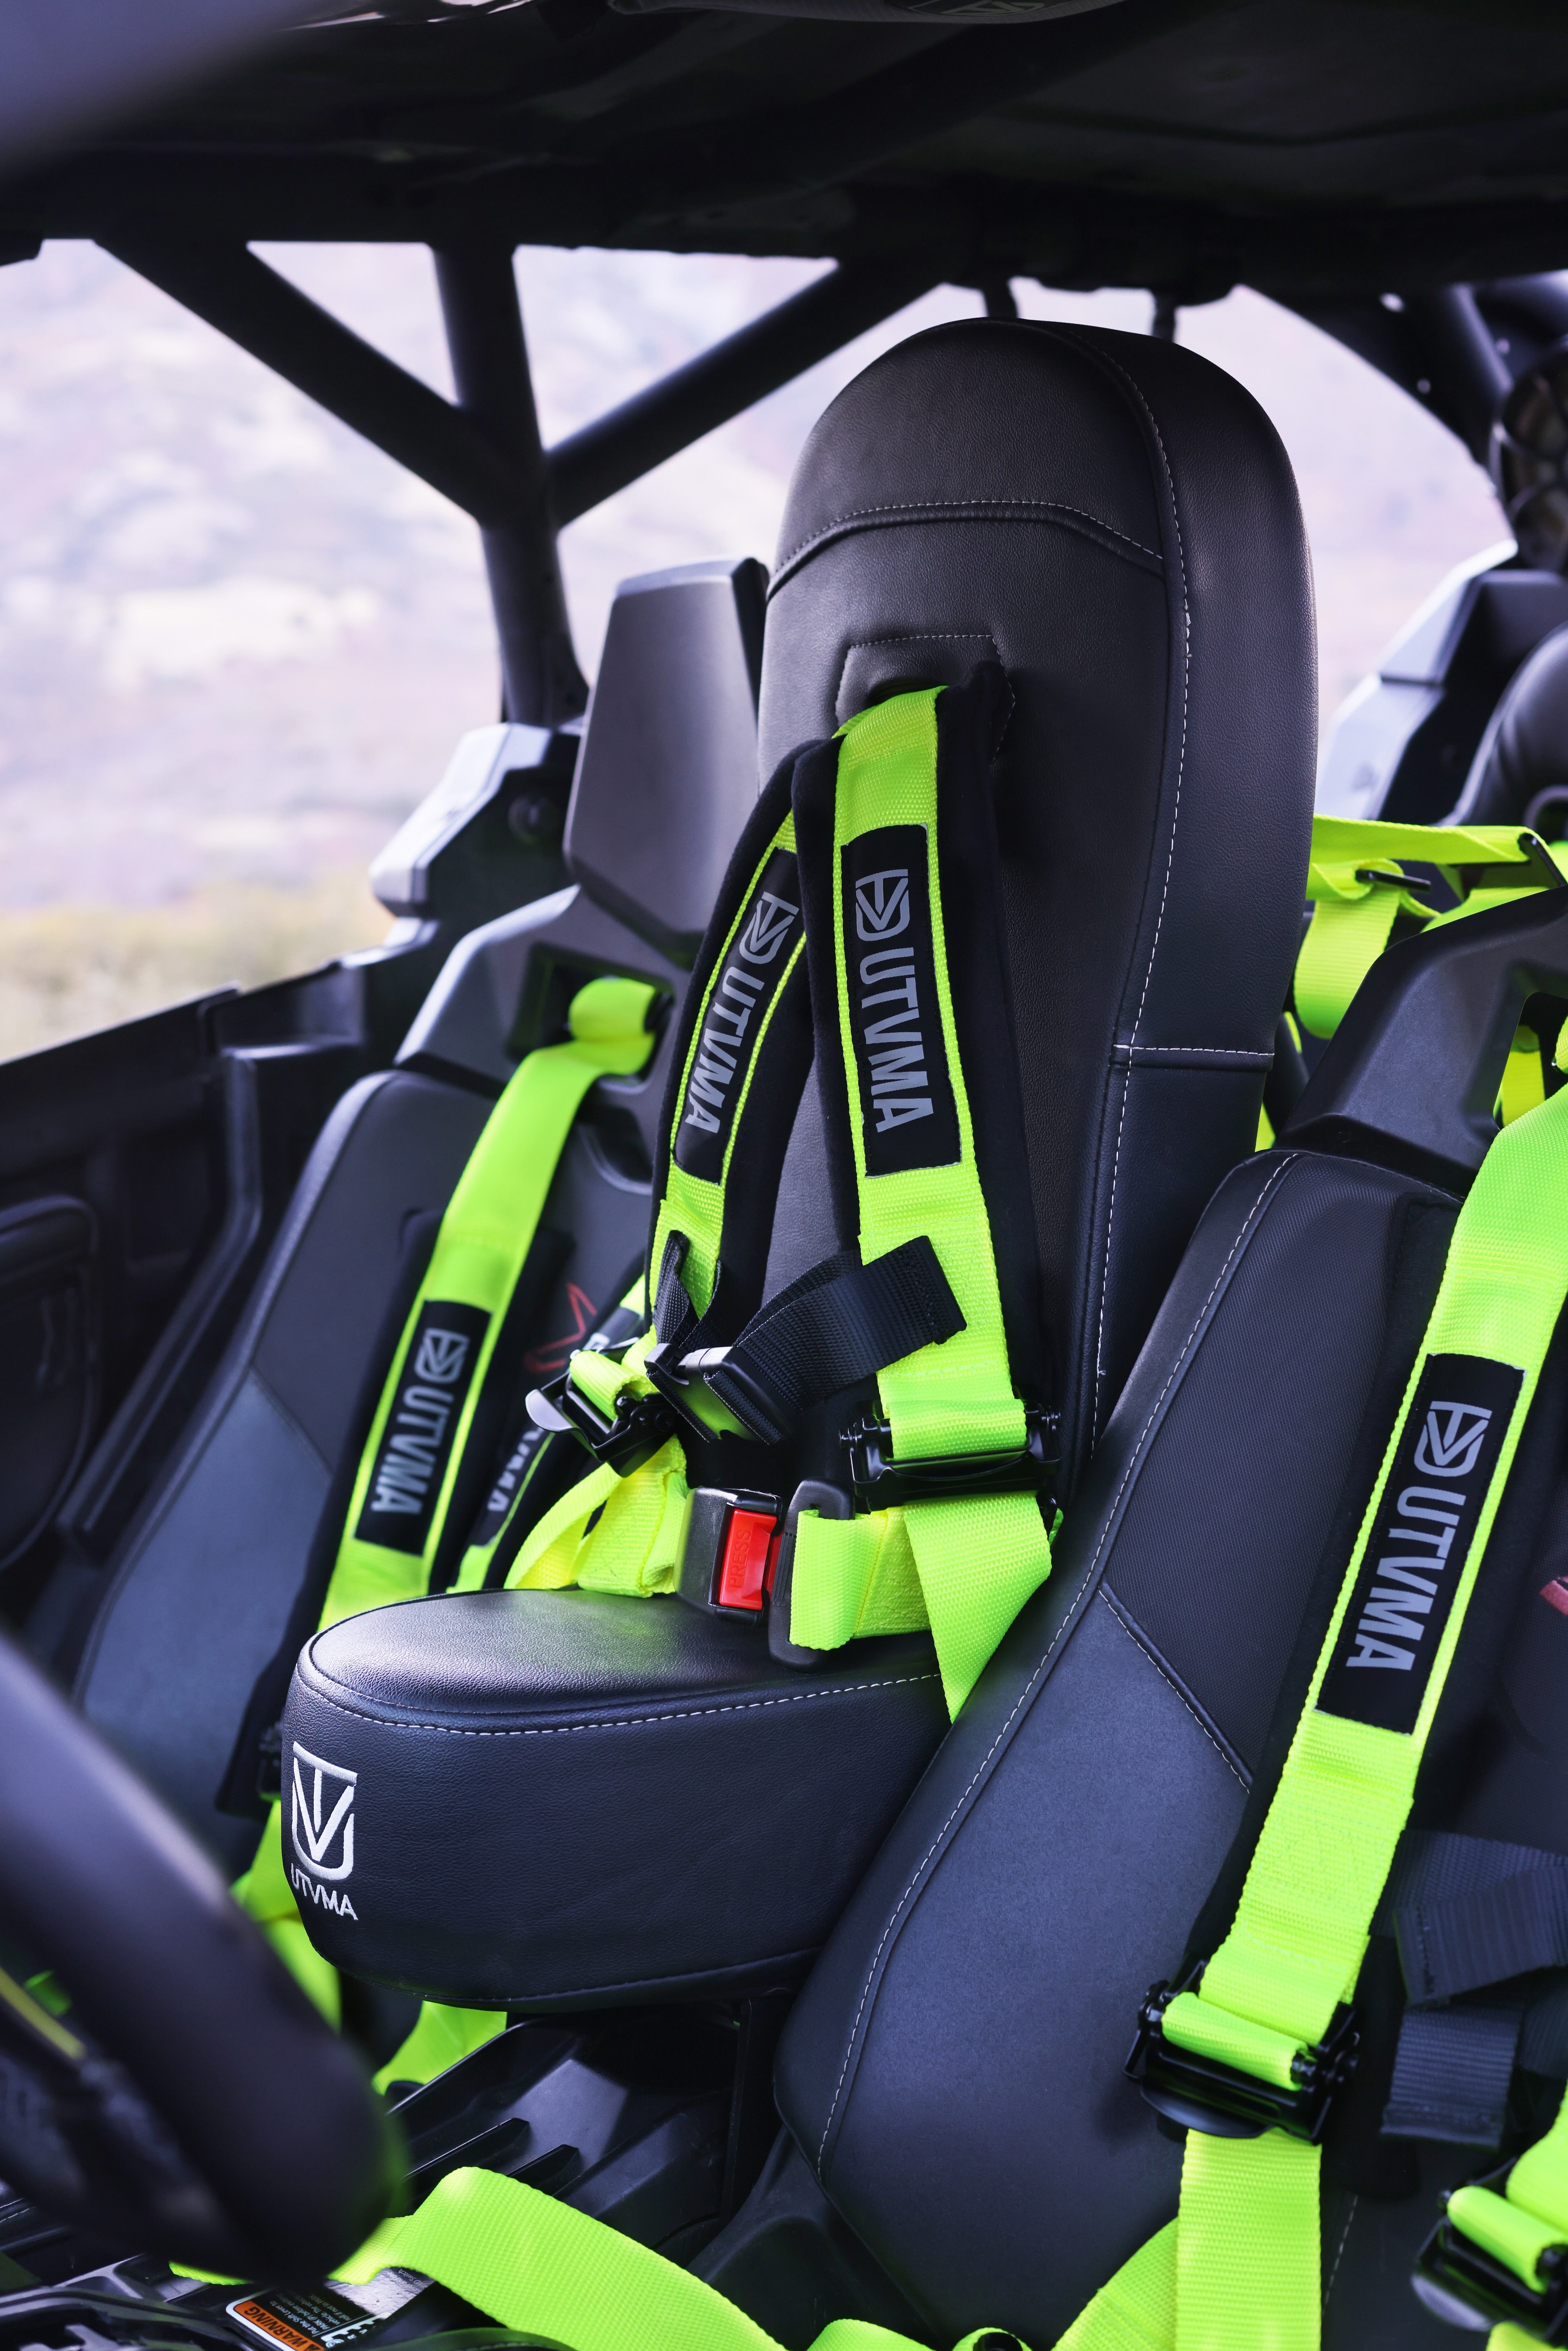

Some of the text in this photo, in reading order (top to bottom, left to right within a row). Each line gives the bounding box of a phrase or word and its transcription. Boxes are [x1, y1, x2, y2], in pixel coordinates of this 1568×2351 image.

[684, 966, 765, 1134] UTVMA
[860, 948, 934, 1132] UTVMA
[370, 1386, 454, 1515] UTVMA
[727, 1530, 751, 1589] PRESS
[1346, 1486, 1466, 1671] UTVMA
[291, 1863, 359, 1921] UTVMA
[398, 2268, 417, 2281] Switch.
[244, 2306, 308, 2347] WARNING
[275, 2305, 291, 2315] Lever
[287, 2313, 302, 2322] Shift
[292, 2305, 310, 2317] before
[313, 2319, 330, 2330] PARK
